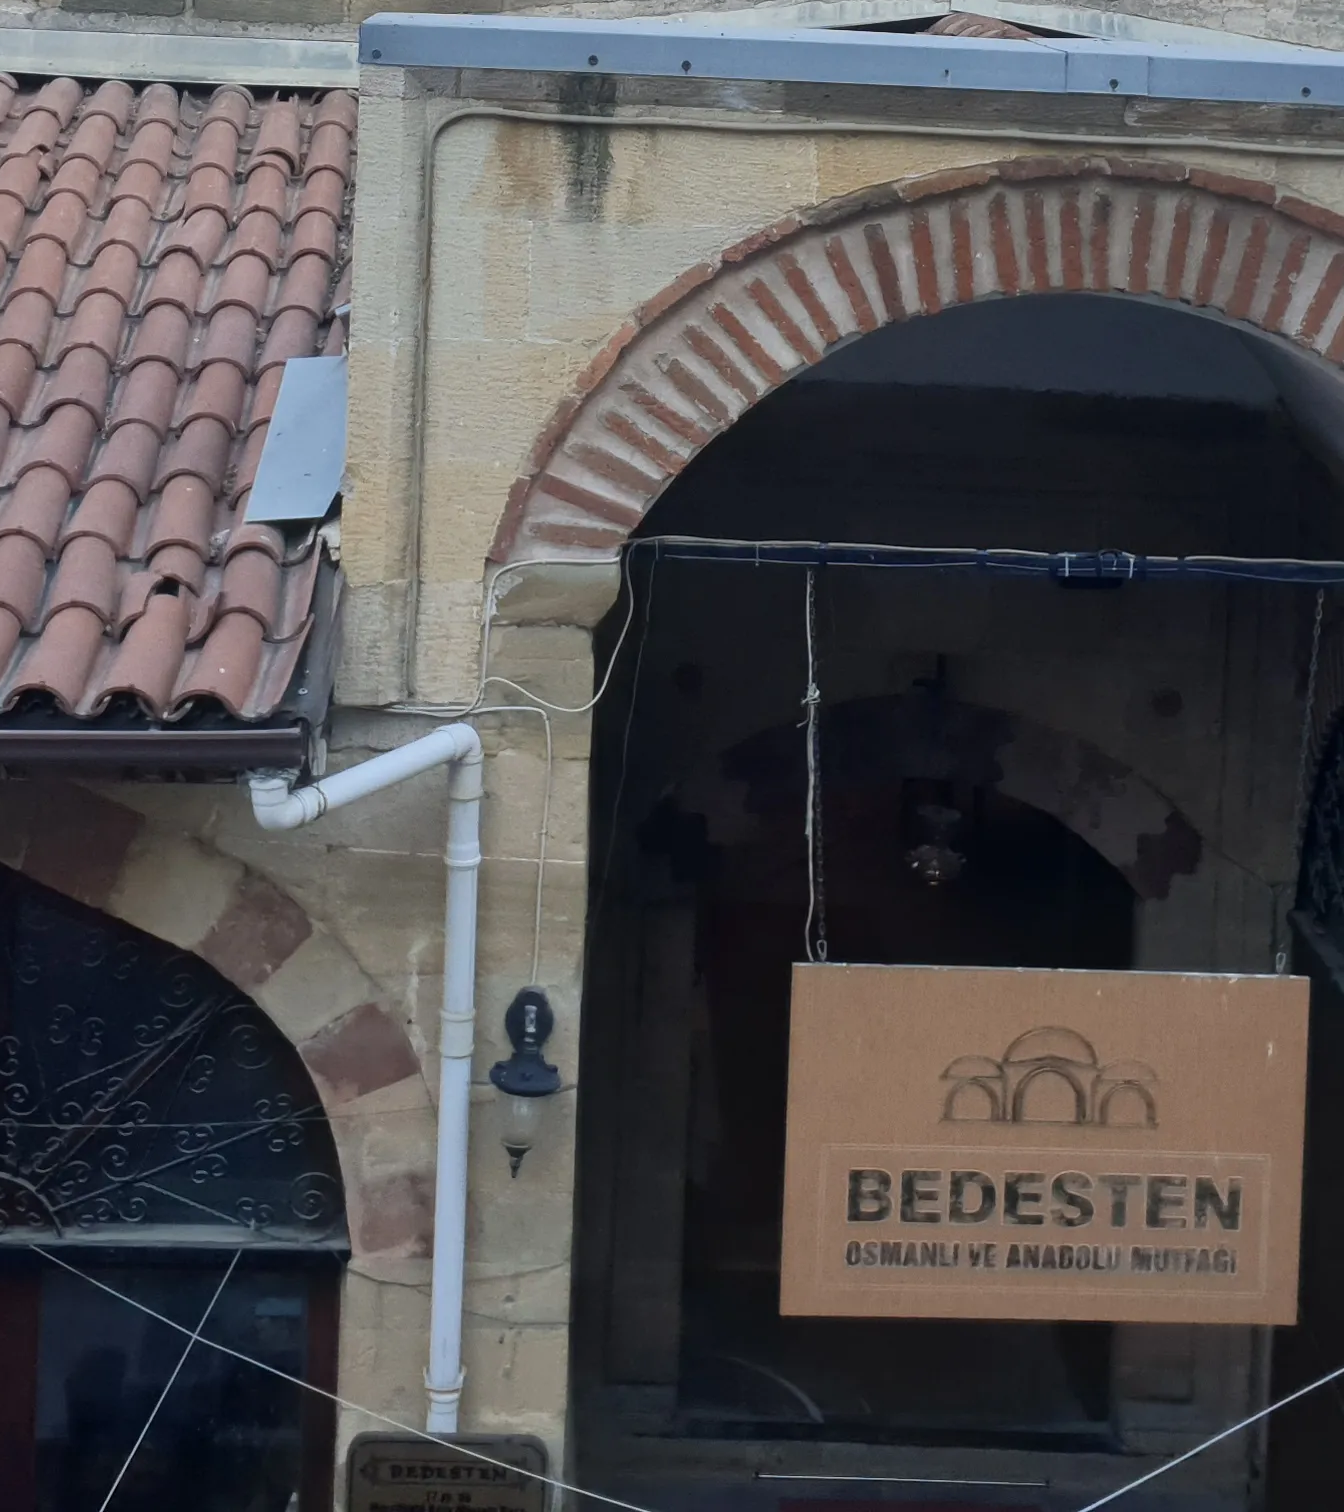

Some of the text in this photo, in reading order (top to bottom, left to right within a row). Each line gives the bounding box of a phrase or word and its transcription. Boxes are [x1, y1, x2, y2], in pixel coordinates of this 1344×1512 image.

[846, 1168, 1243, 1231] BEDESTEN
[845, 1239, 960, 1268] OSMANLI
[967, 1241, 998, 1269] VE
[1005, 1242, 1121, 1272] ANADOLU
[390, 1464, 507, 1482] BEDESTEN
